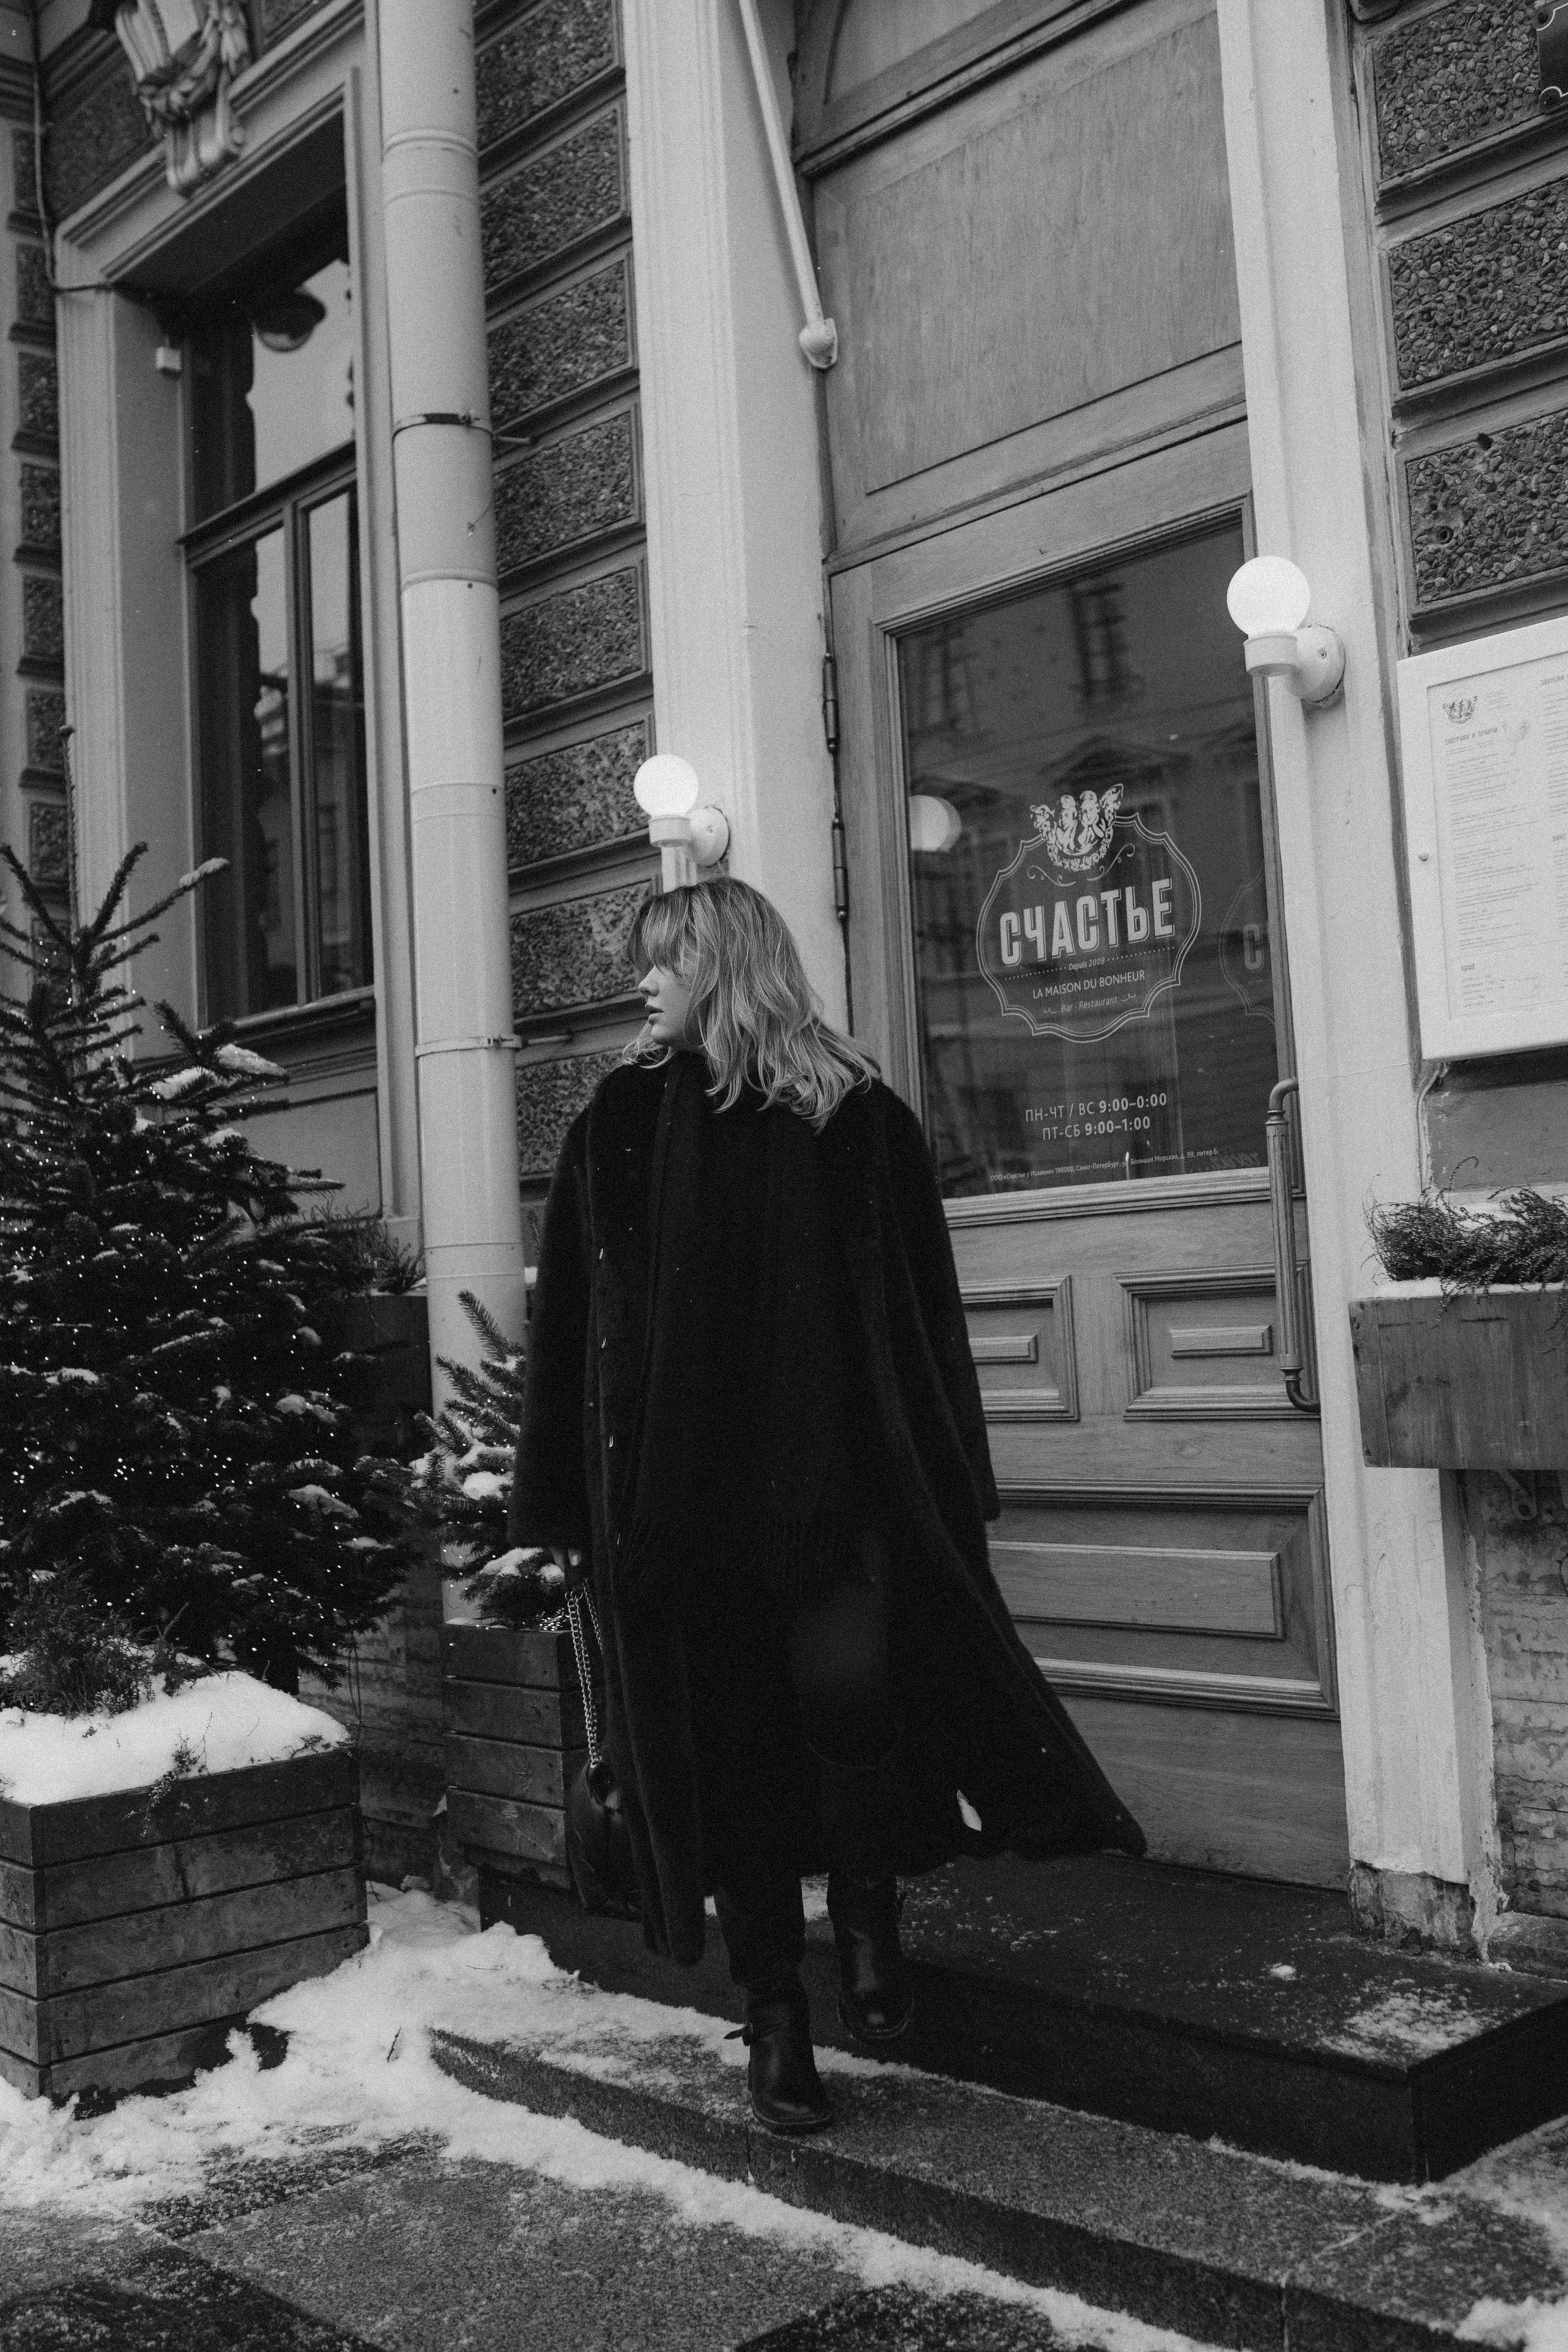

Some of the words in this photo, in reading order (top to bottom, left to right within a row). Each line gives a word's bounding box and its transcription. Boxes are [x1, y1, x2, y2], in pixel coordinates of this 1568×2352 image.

[1444, 734, 1469, 745] ЗАВТРАКИ
[1000, 878, 1175, 968] СЧАСТЬЕ
[1068, 960, 1087, 971] Depuis
[1089, 957, 1106, 967] 2008
[1033, 989, 1044, 1000] LA
[1045, 981, 1082, 997] MAISON
[1084, 978, 1097, 990] DU
[1099, 970, 1145, 987] BONHEUR
[1061, 1003, 1073, 1013] Bar
[1079, 996, 1117, 1010] Restaurant
[1025, 1104, 1065, 1122] ПН-ЧТ
[1069, 1103, 1074, 1118] /
[1079, 1101, 1095, 1116] ВС
[1042, 1124, 1080, 1140] ПТ-СБ
[1076, 1161, 1121, 1171] Санкт-Петербург,
[1131, 1155, 1153, 1165] Большая
[1155, 1153, 1180, 1163] Морская,
